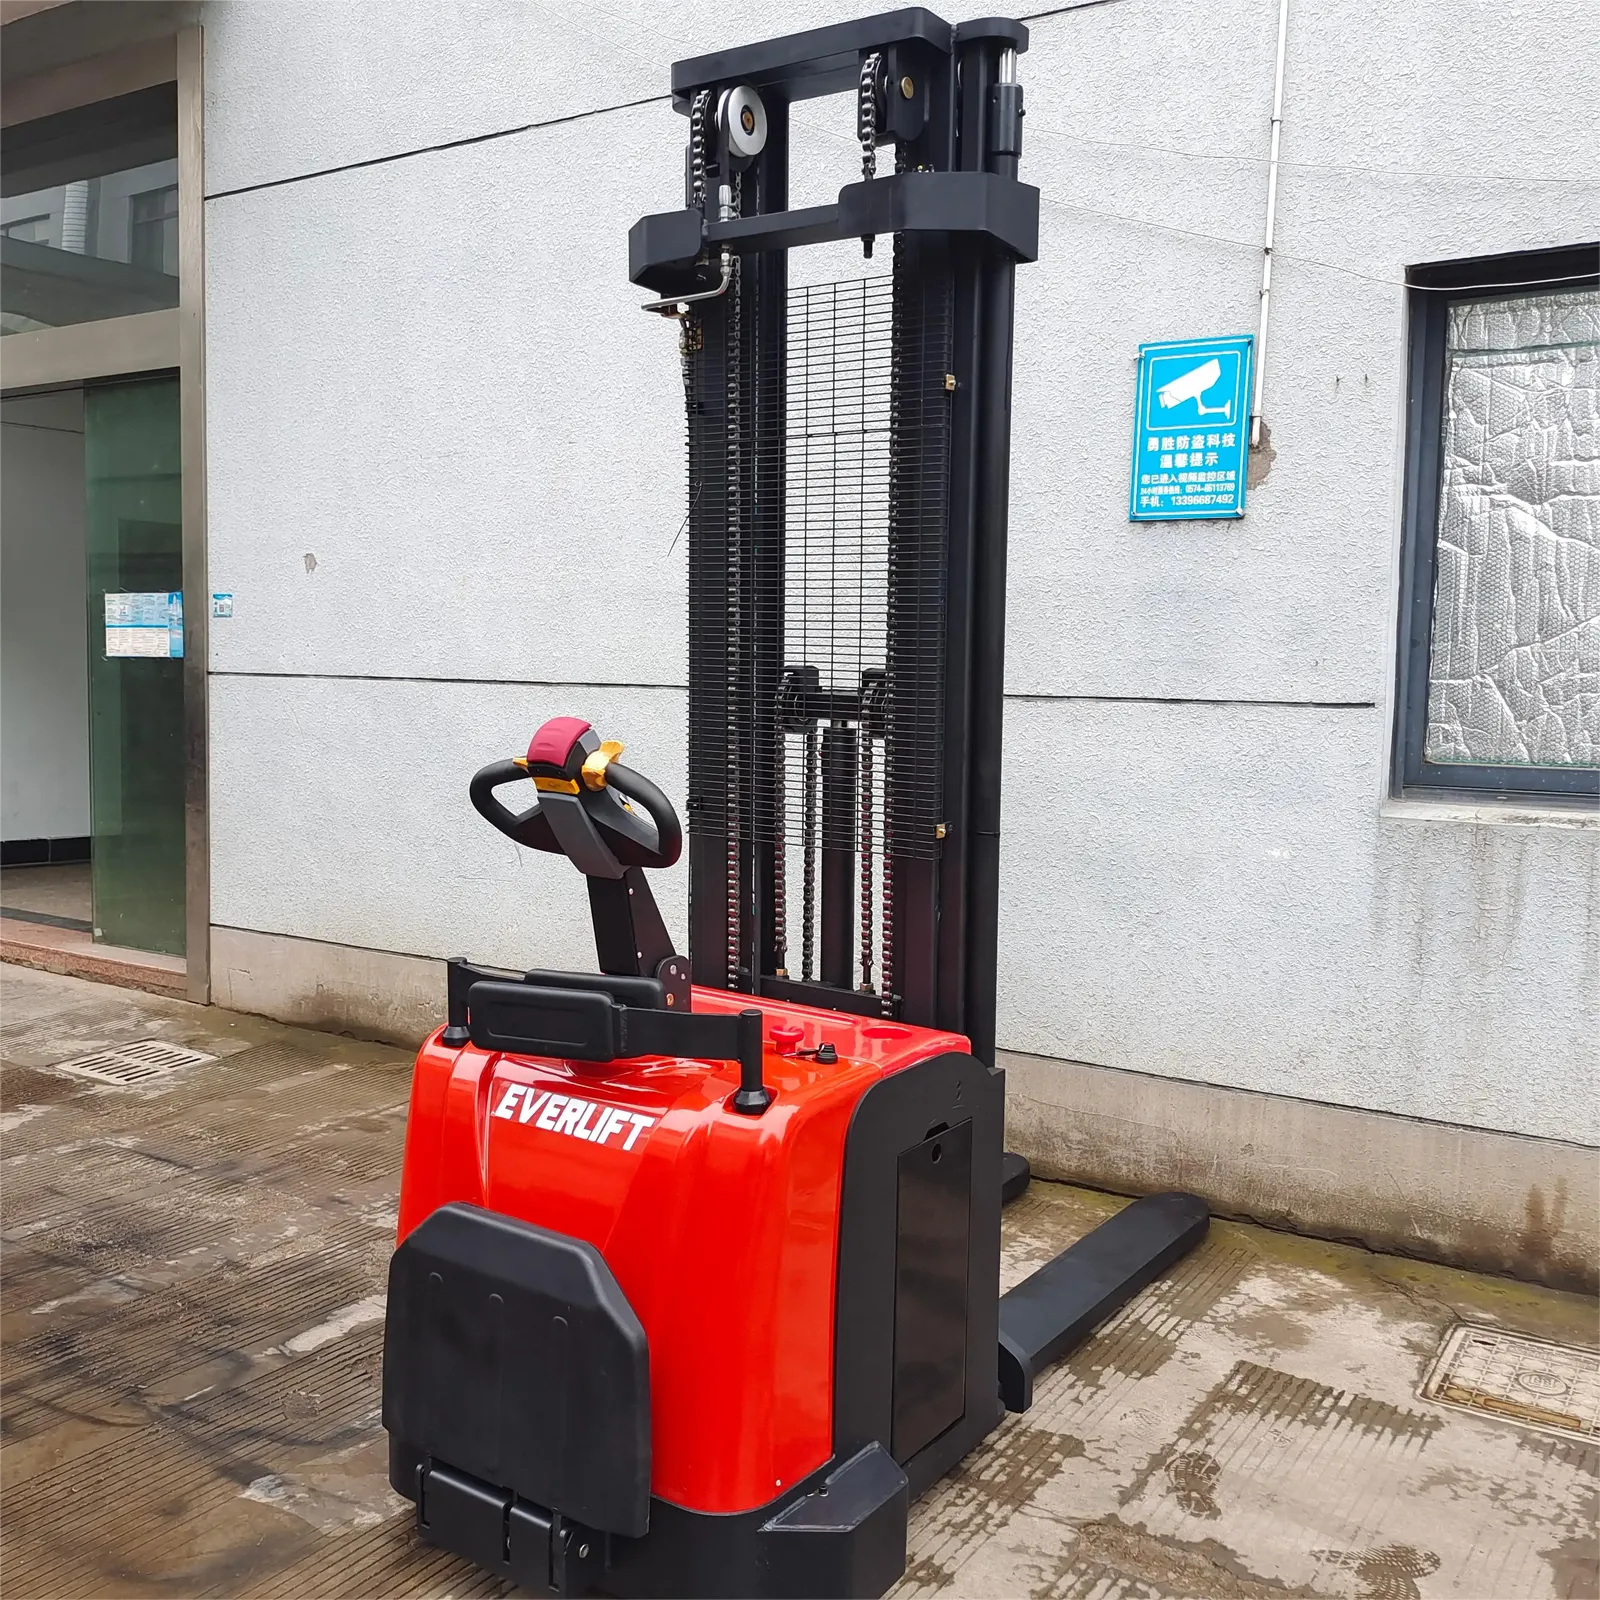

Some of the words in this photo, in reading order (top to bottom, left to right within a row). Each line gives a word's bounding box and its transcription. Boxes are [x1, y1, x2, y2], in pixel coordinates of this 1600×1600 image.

[1159, 452, 1219, 468] 温馨提示
[1140, 470, 1236, 485] 您已进入视频监控区域
[1171, 494, 1235, 506] 13396687492
[495, 1083, 656, 1151] EVERLIFT
